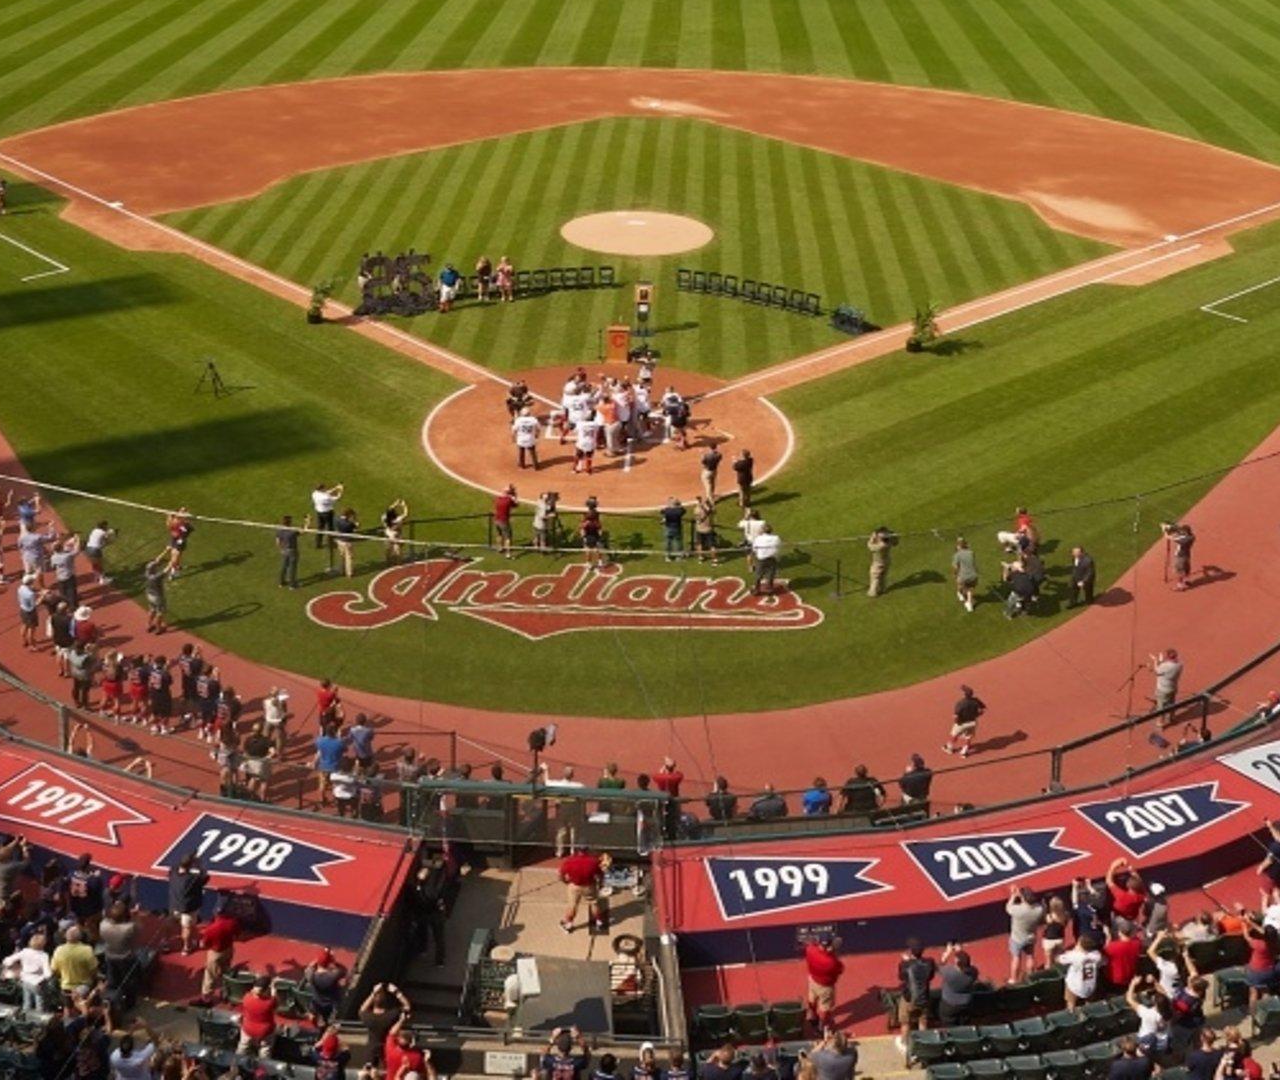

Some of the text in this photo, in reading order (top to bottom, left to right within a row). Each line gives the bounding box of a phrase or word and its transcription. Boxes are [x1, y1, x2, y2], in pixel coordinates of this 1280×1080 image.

[306, 557, 825, 640] Indians
[5, 778, 106, 826] 1997
[1105, 794, 1200, 839] 2007
[195, 828, 293, 872] 1998
[934, 837, 1038, 882] 2001
[729, 863, 830, 901] 1999
